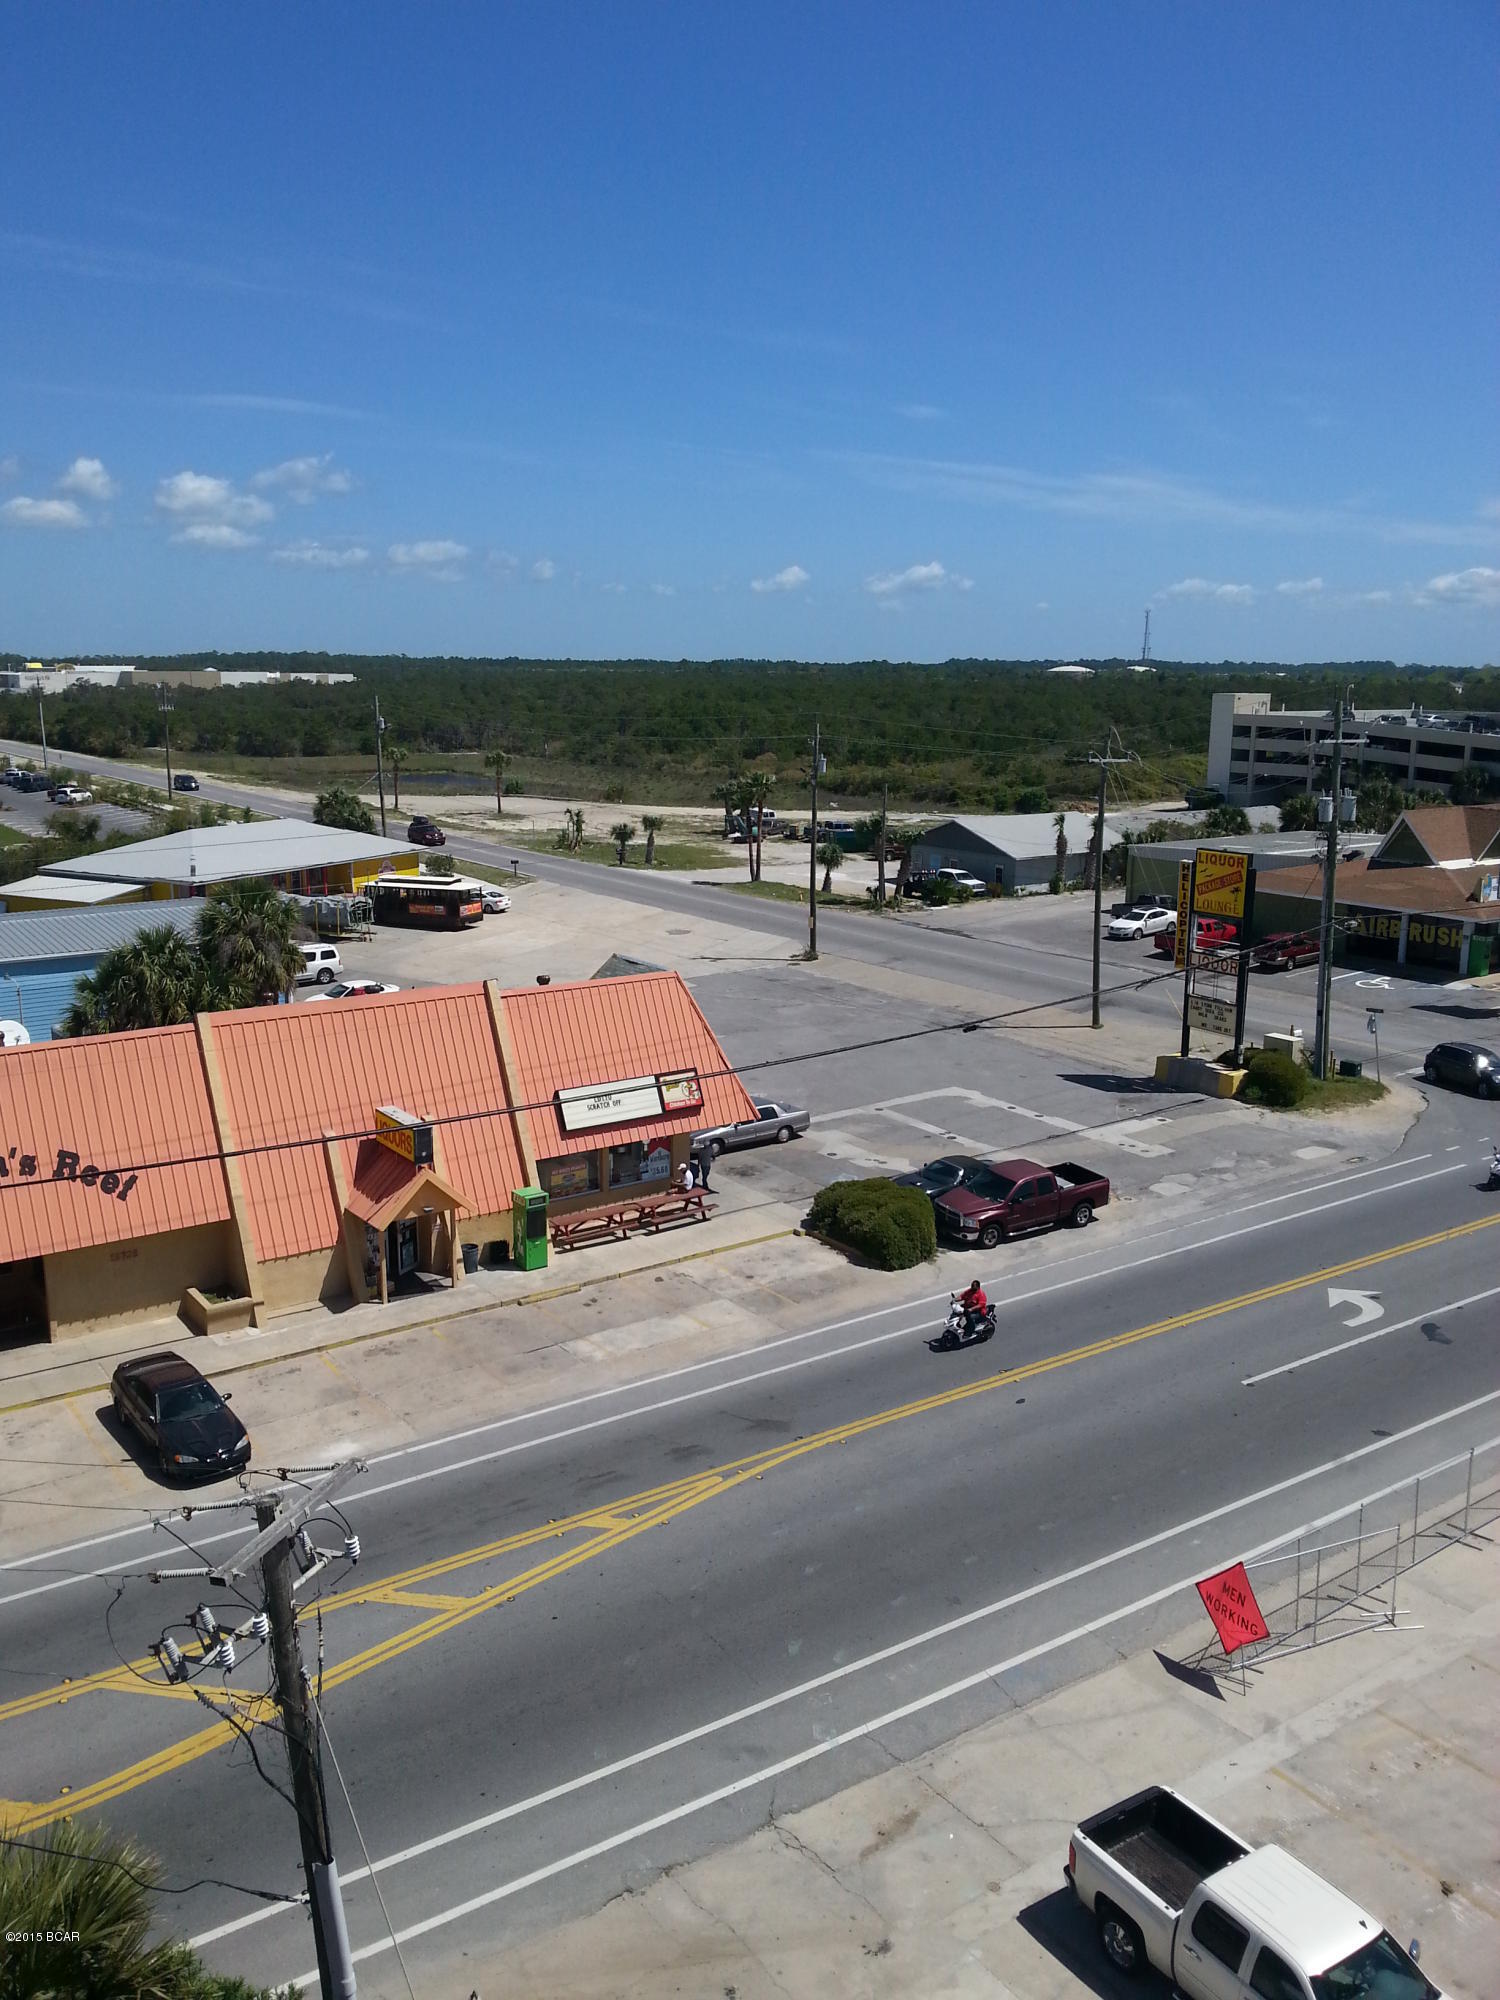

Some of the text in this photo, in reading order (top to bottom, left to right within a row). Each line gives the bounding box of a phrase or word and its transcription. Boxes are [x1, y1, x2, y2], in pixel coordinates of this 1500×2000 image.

[1198, 852, 1245, 869] LIQUOR
[1198, 871, 1242, 895] PACKAGE STORE
[1176, 863, 1191, 957] HELICOPTER
[1196, 897, 1240, 915] LOUNGE
[1189, 953, 1238, 974] LIQUOR
[586, 1099, 622, 1111] SCRATCH OFF
[375, 1115, 413, 1155] LIQUORS
[52, 1149, 139, 1202] Reef
[1222, 1581, 1247, 1608] MEN
[1206, 1591, 1258, 1636] WORKING
